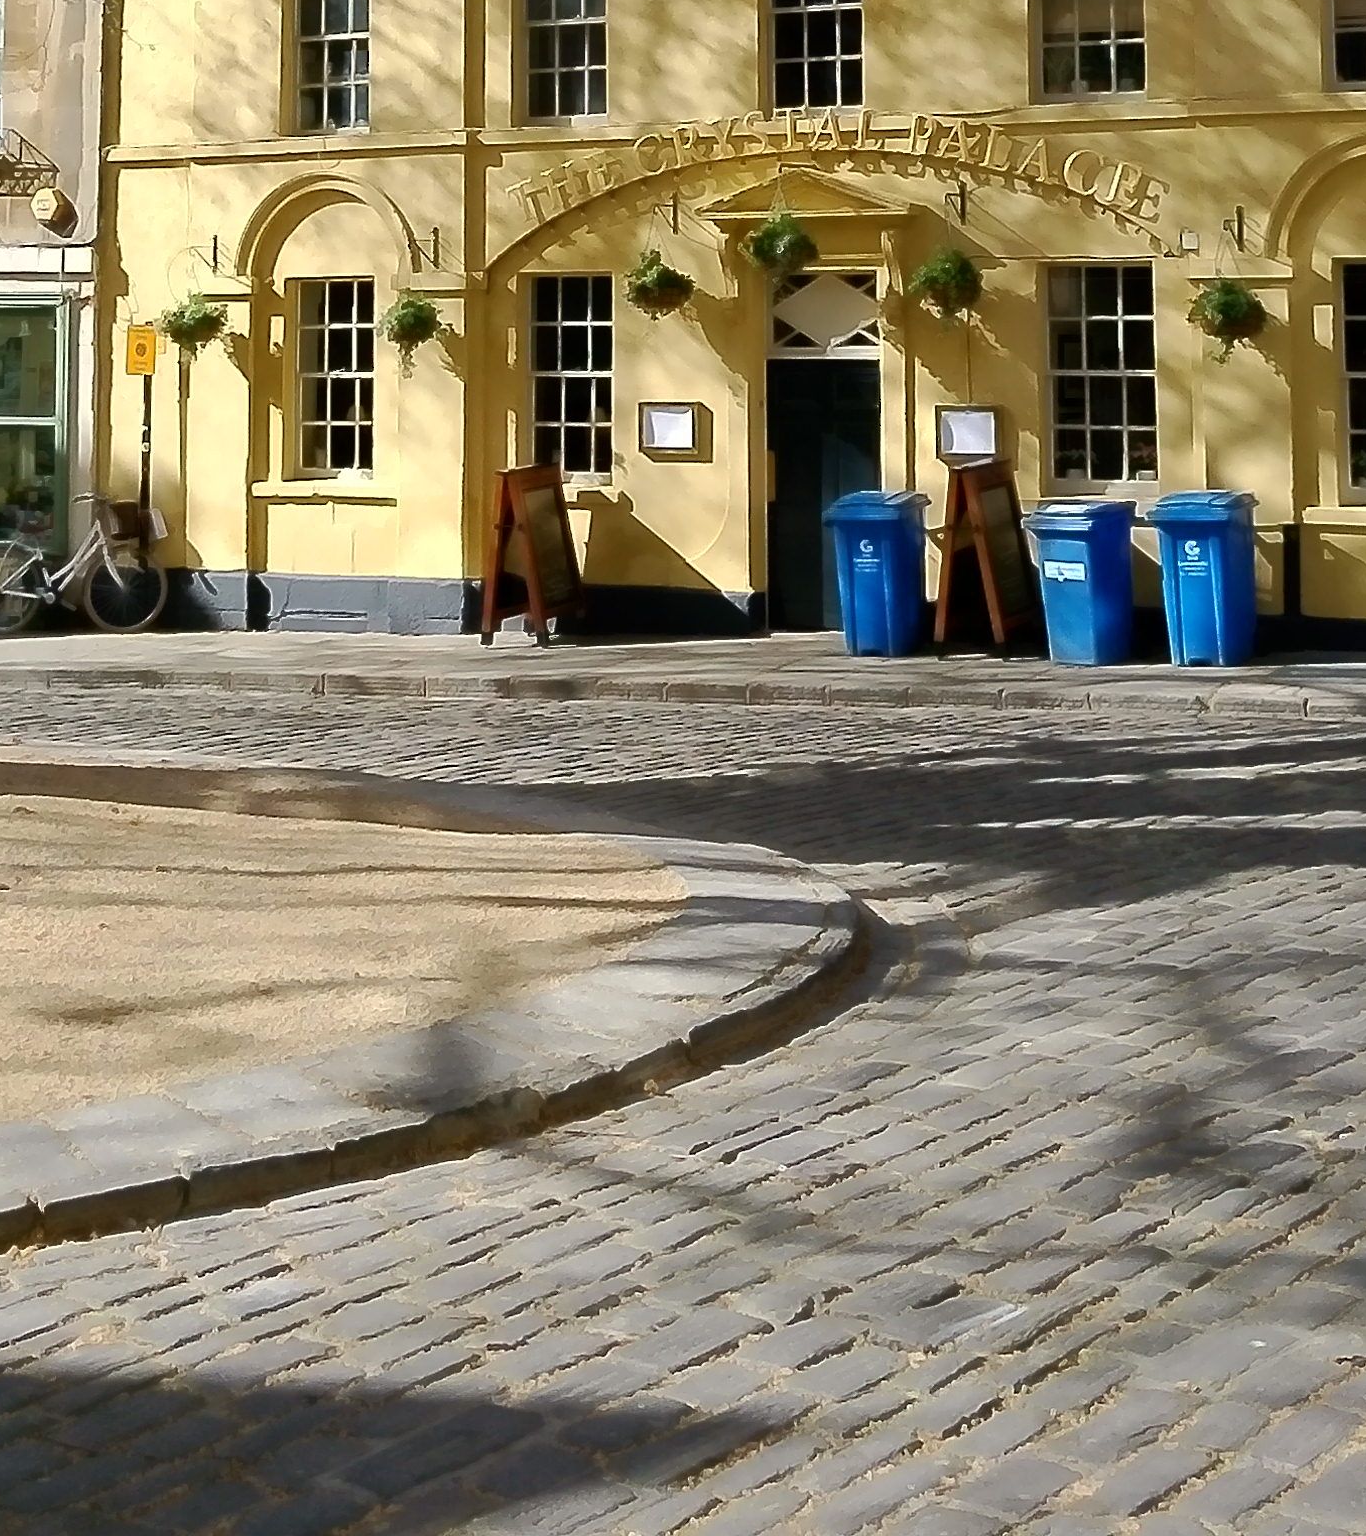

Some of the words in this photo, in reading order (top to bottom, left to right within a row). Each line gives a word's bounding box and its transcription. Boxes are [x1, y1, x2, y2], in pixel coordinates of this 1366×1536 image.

[505, 151, 621, 223] THE
[632, 106, 884, 175] CRYSTAL
[911, 112, 1151, 212] PALACE
